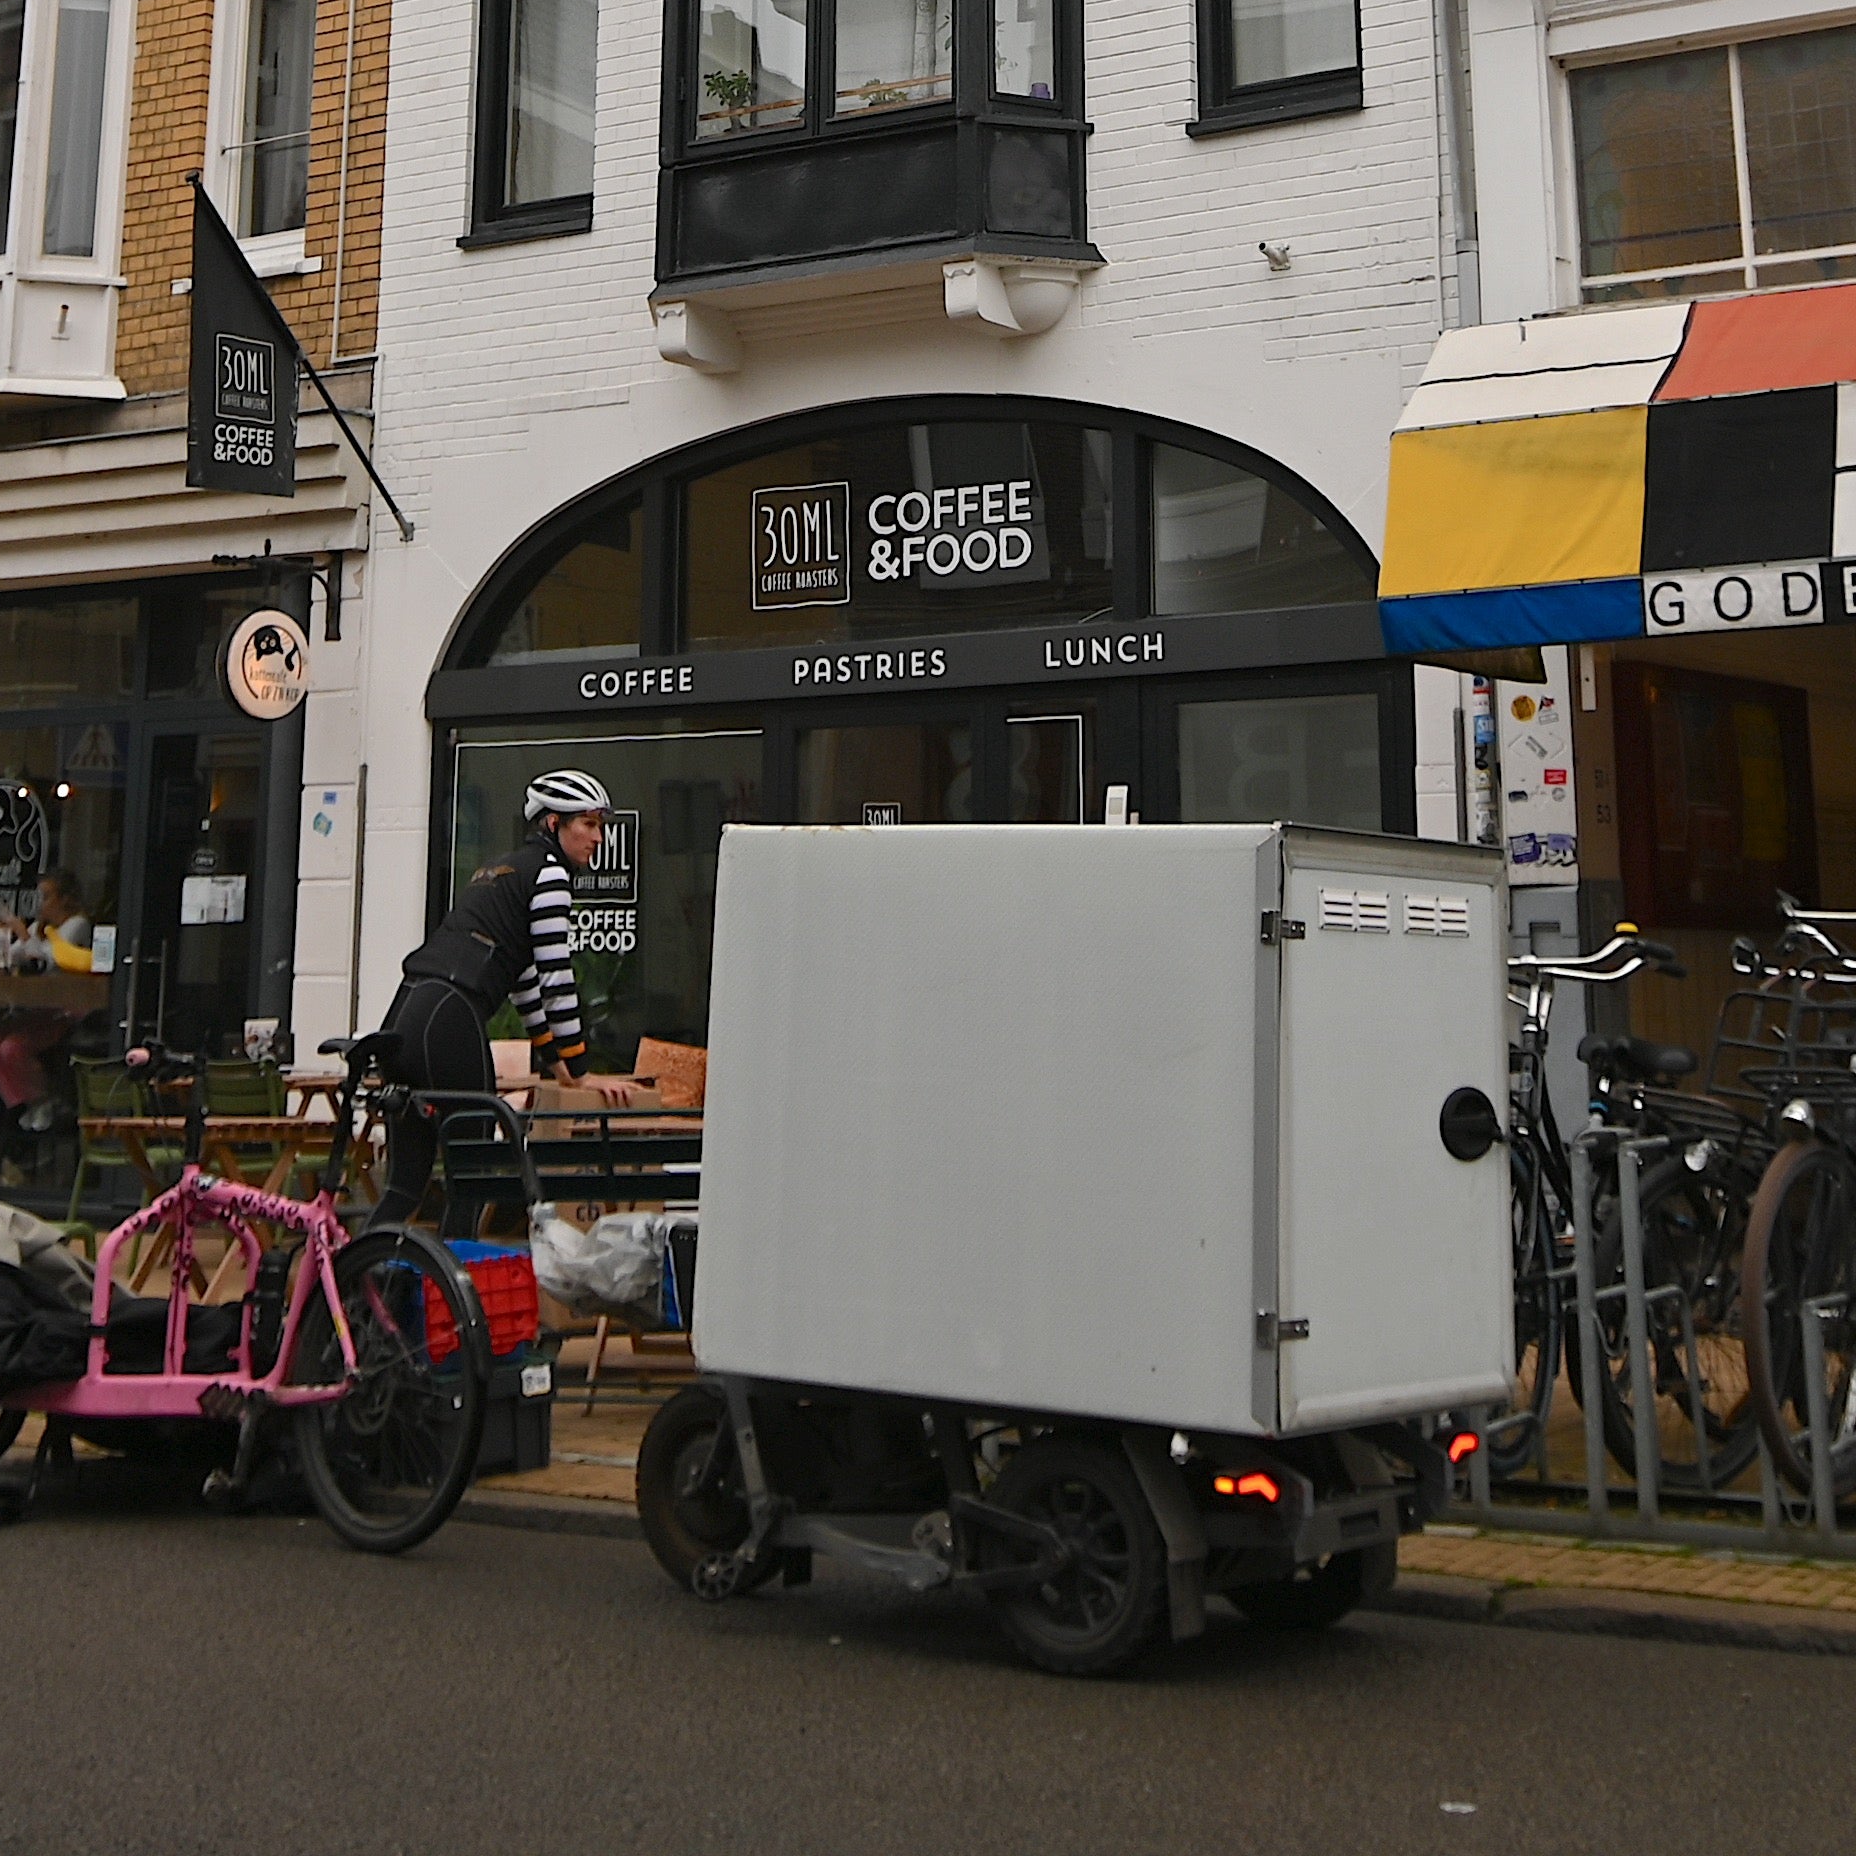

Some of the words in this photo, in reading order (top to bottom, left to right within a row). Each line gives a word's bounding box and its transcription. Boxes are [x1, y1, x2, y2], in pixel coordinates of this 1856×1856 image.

[221, 346, 269, 394] 30ML
[215, 423, 275, 448] COFFEE
[214, 442, 274, 466] &FOOD
[868, 480, 1032, 535] COFFEE
[760, 499, 840, 568] 30ML
[868, 527, 1032, 581] &FOOD
[761, 571, 793, 593] COFFEE
[795, 568, 839, 590] ROASTERS
[792, 648, 948, 686] PASTRIES
[1043, 631, 1166, 669] LUNCH
[579, 665, 695, 699] COFFEE
[569, 909, 637, 931] COFFEE
[567, 930, 636, 952] &FOOD
